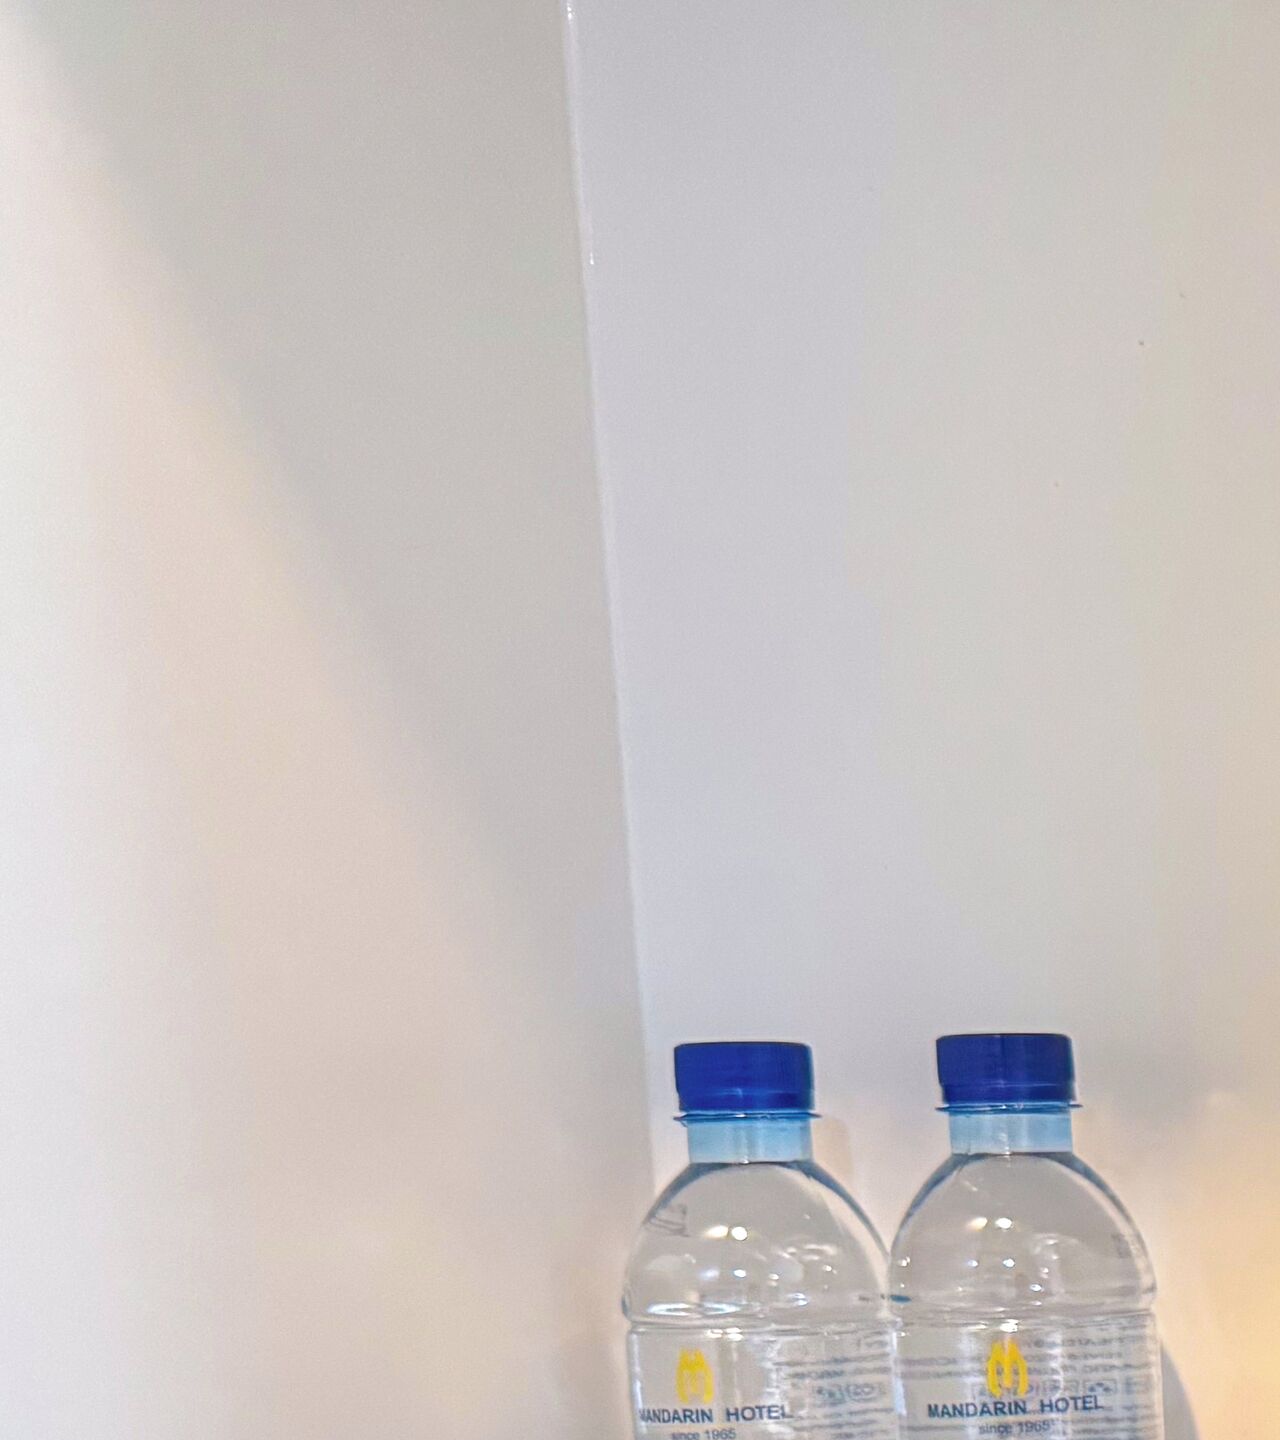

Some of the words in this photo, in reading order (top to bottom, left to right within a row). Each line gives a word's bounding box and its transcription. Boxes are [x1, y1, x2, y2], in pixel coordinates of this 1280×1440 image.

[726, 1404, 793, 1421] HOTEL
[928, 1400, 1027, 1418] MANDARIN
[1040, 1396, 1104, 1413] HOTEL
[671, 1431, 700, 1440] since
[705, 1428, 736, 1440] 1965
[978, 1423, 1013, 1435] since
